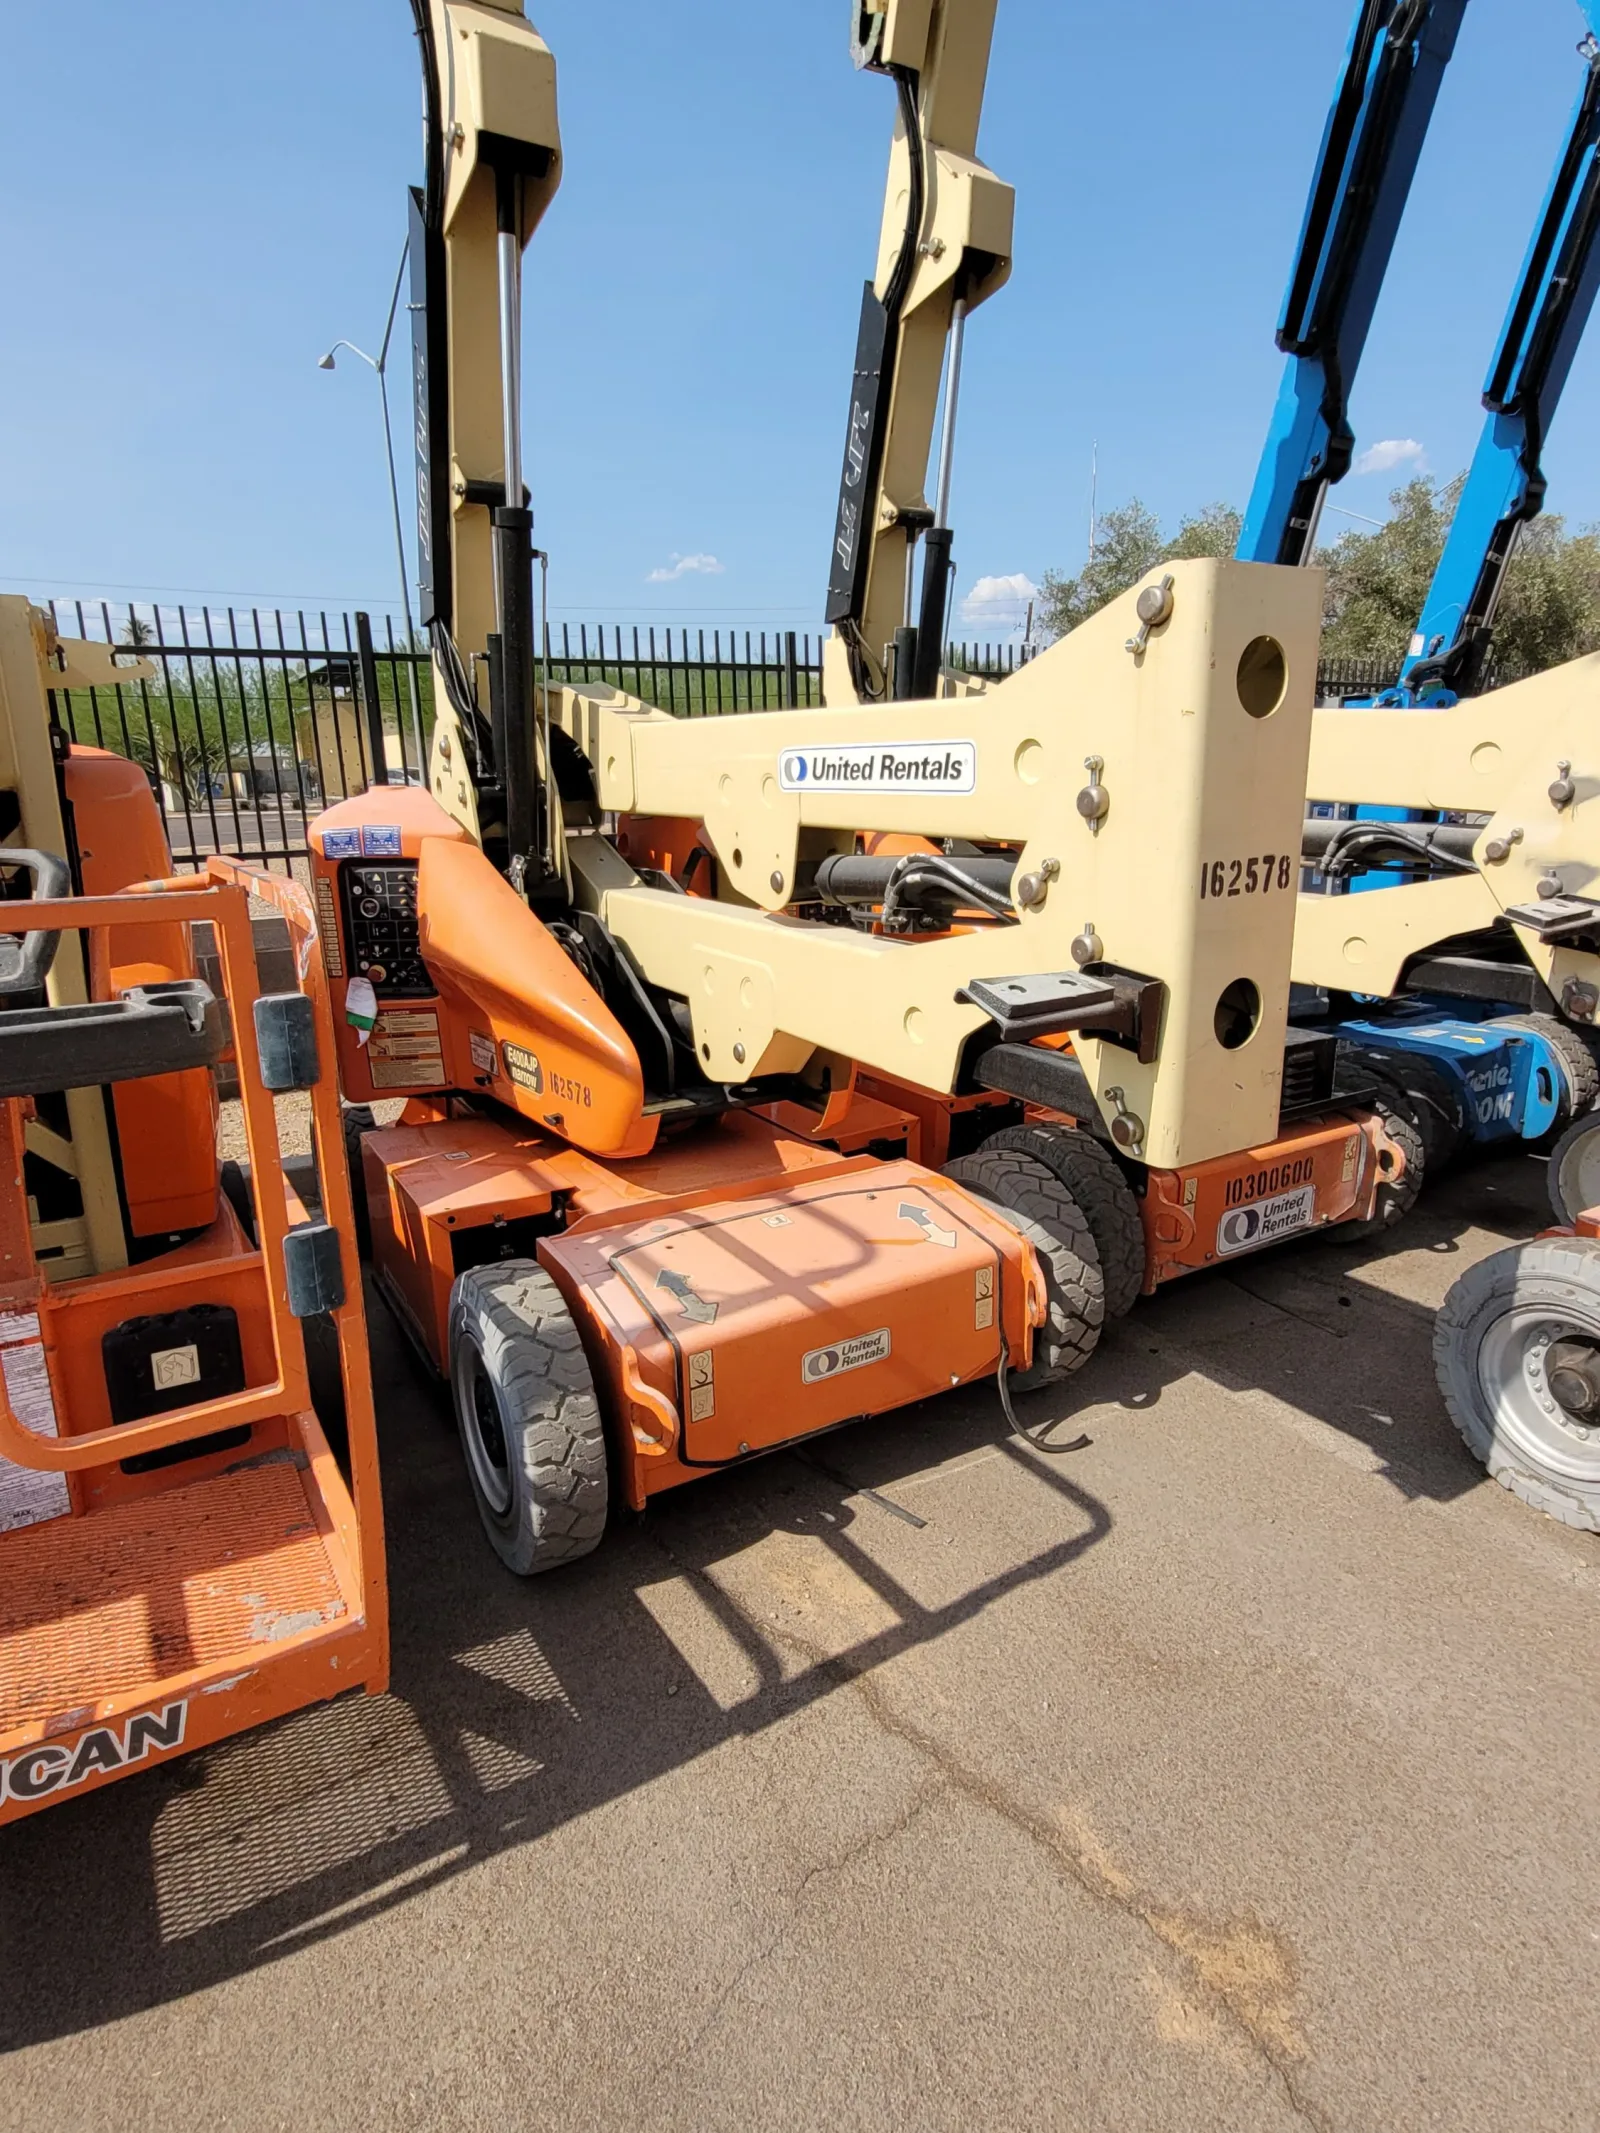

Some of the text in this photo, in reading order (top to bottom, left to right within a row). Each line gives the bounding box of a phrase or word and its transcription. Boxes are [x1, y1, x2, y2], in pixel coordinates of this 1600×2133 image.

[812, 752, 963, 781] United Rentals
[1200, 854, 1291, 899] 162578
[507, 1046, 538, 1073] E400AJP
[511, 1065, 537, 1088] narrow
[549, 1071, 592, 1108] 162578
[1225, 1156, 1314, 1206] 10300600
[1263, 1192, 1306, 1218] United
[1261, 1208, 1308, 1235] Rentals
[841, 1334, 882, 1357] United
[841, 1346, 886, 1368] Rentals
